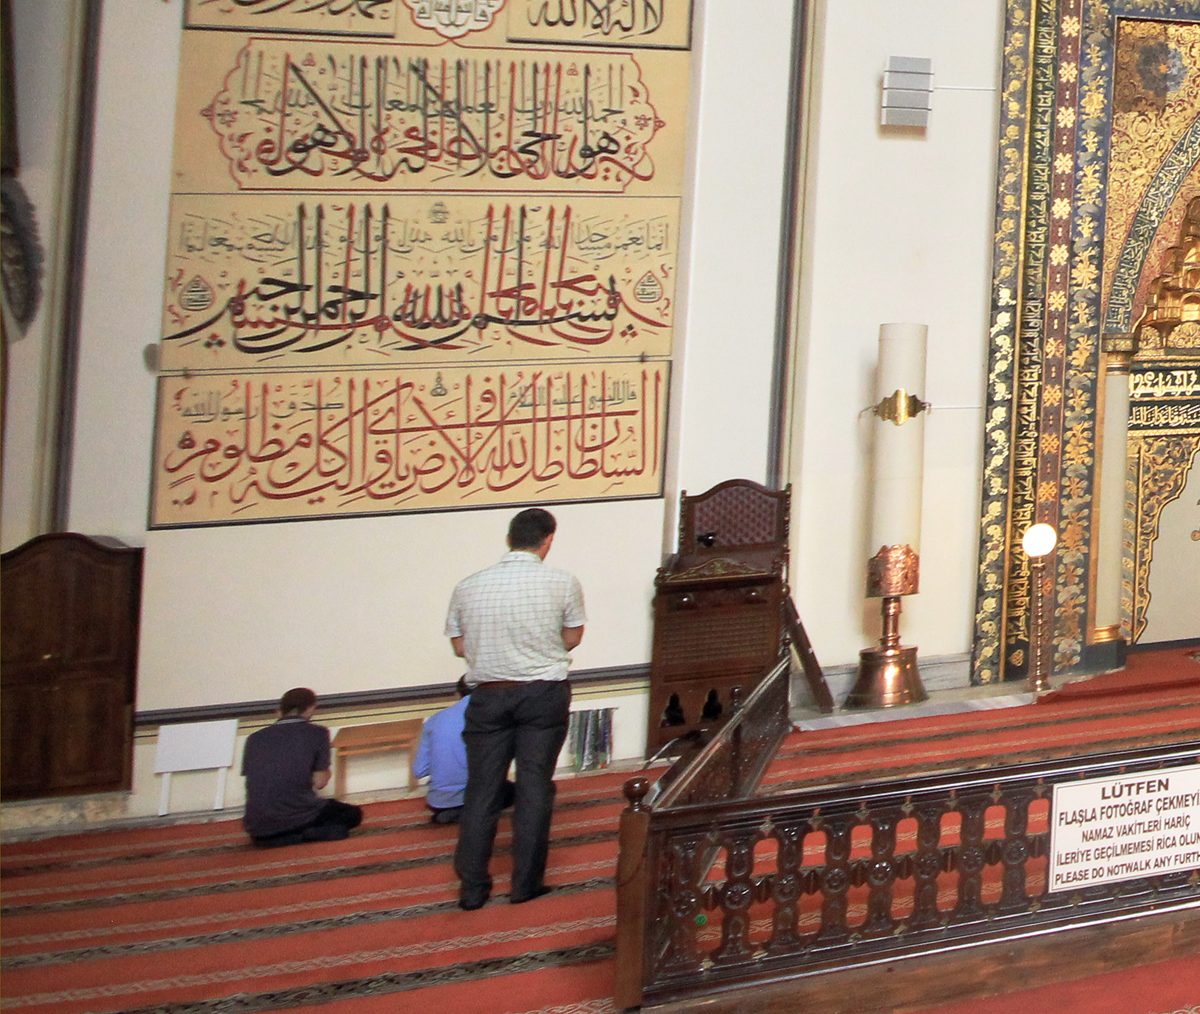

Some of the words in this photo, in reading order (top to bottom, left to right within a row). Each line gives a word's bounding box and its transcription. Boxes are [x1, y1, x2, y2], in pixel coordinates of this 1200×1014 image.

[1101, 778, 1169, 800] LÜTFEN
[1058, 807, 1097, 828] FLAŞLA
[1100, 799, 1153, 821] FOTOĞRAF
[1081, 826, 1113, 843] NAMAZ
[1116, 816, 1162, 837] VAKİTLERİ
[1164, 813, 1191, 831] HARİÇ
[1056, 848, 1091, 867] İLERİYE
[1093, 837, 1154, 862] GEÇİLMEMESİ
[1156, 833, 1177, 849] RİCA
[1055, 868, 1089, 885] PLEASE
[1092, 867, 1104, 878] DO
[1153, 855, 1172, 869] ANY
